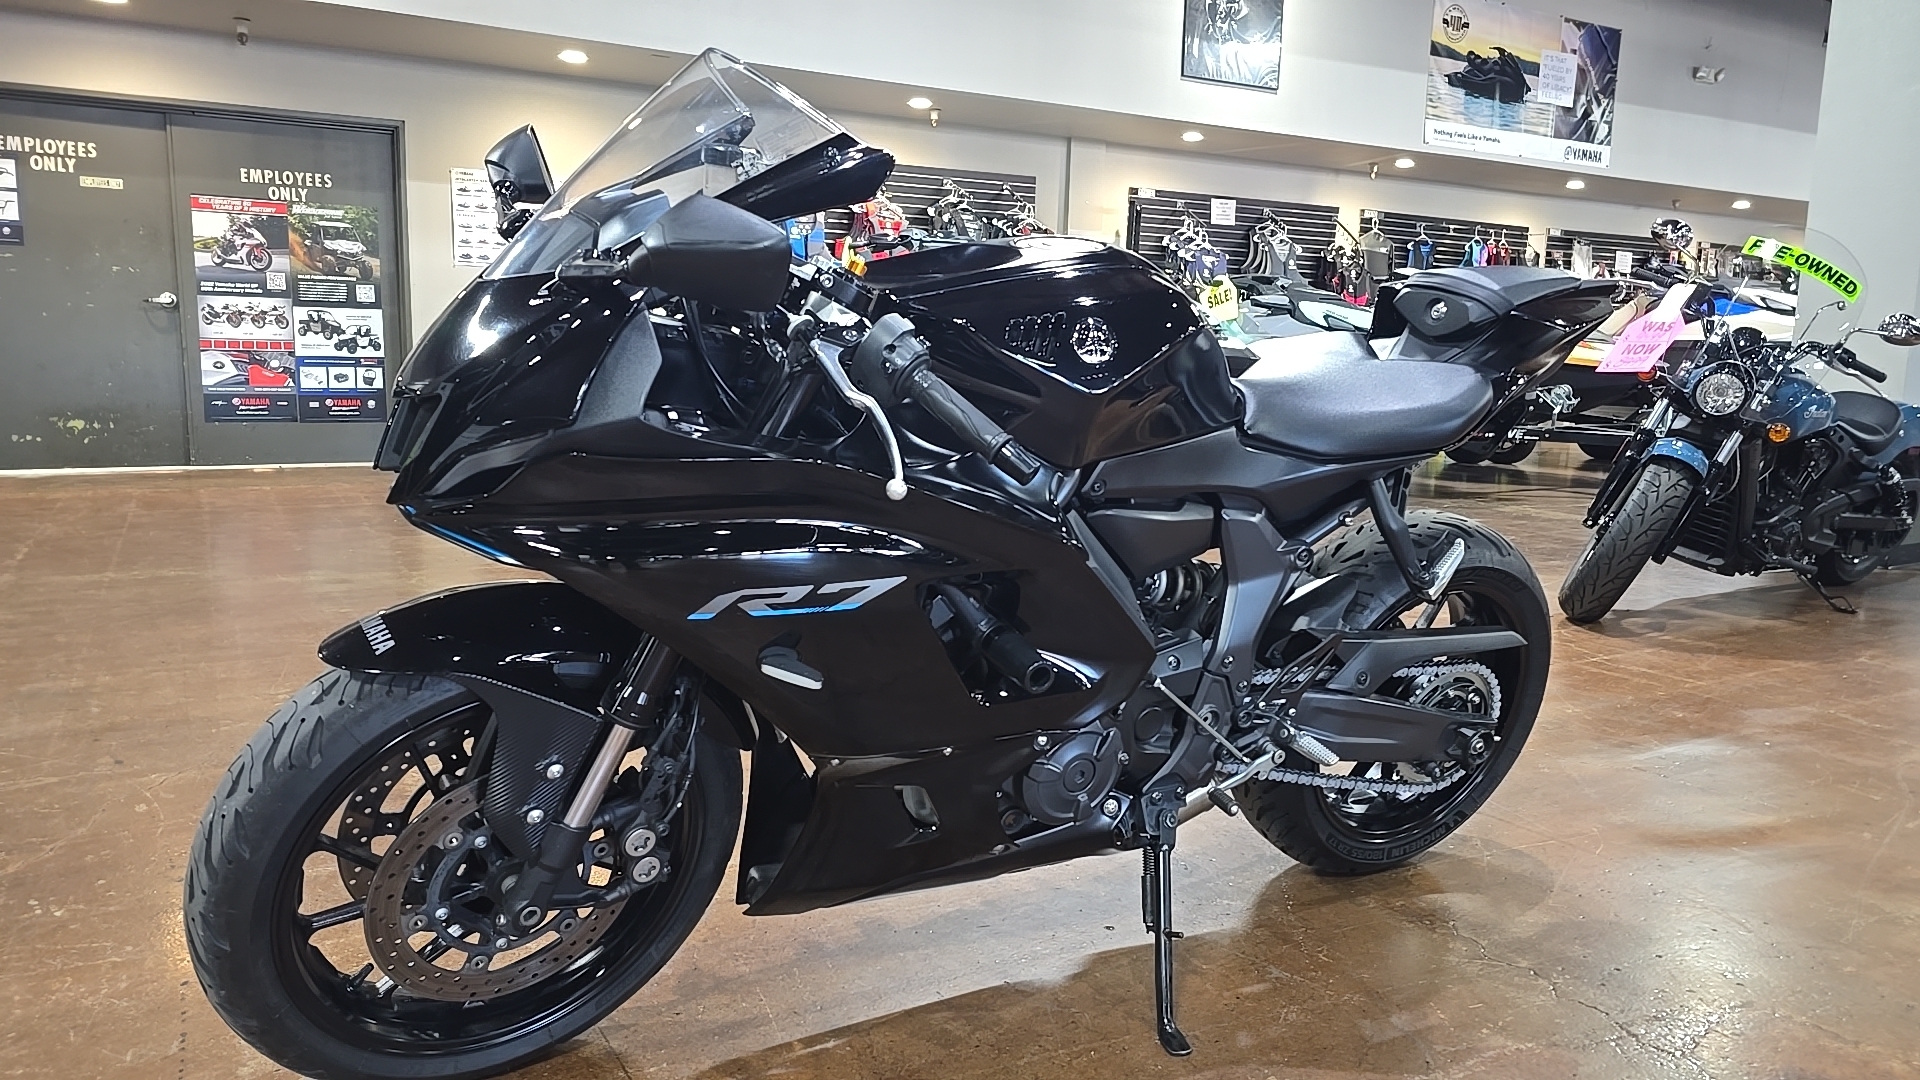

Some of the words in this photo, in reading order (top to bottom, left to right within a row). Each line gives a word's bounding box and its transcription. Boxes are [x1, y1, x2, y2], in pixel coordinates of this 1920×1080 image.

[29, 154, 77, 173] ONLY
[240, 167, 333, 189] EMPLOYEES
[267, 186, 308, 202] ONLY
[1748, 238, 1859, 297] PE-OWNED
[1207, 288, 1232, 309] SALE!
[1641, 321, 1677, 332] WAS
[1620, 343, 1662, 355] NOW
[241, 397, 270, 406] YAMAHA
[334, 399, 361, 407] YAMAHA
[686, 575, 908, 620] R7
[360, 615, 396, 656] MAHA
[1338, 843, 1351, 855] ZR
[1391, 826, 1447, 858] MICHELIN
